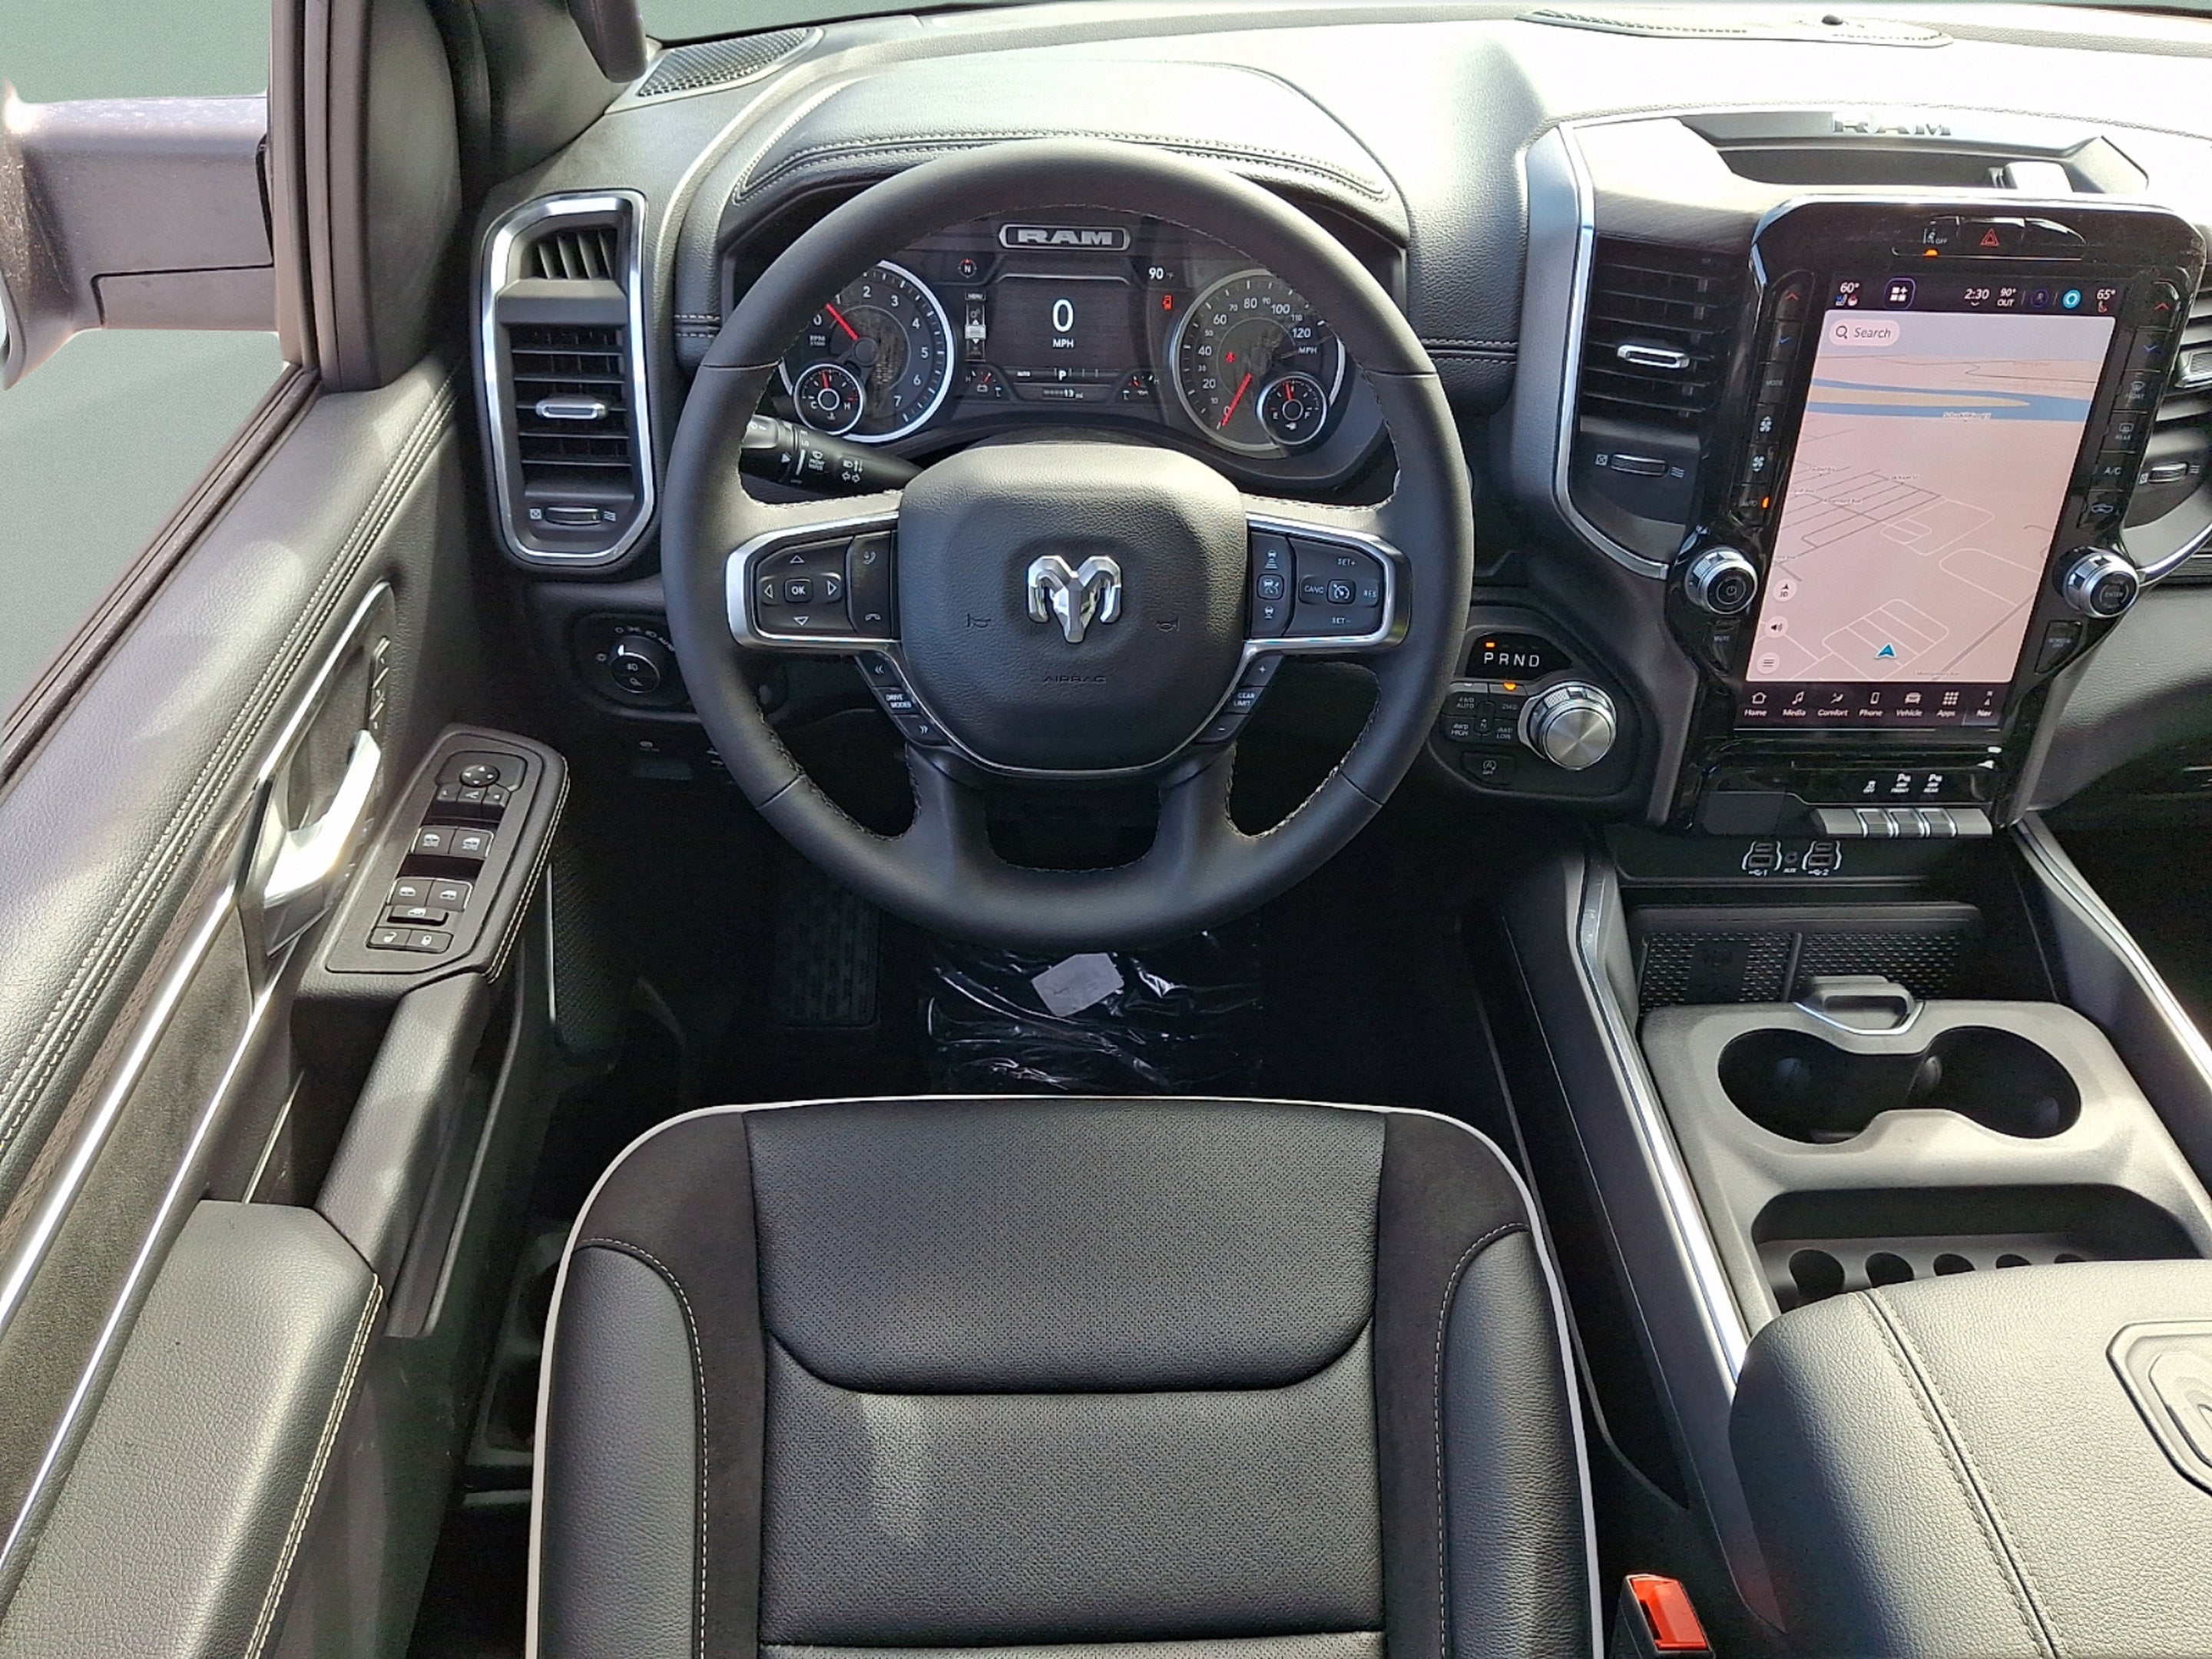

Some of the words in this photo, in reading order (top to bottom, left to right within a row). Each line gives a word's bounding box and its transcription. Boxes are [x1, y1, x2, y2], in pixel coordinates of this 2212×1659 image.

[1833, 119, 1952, 136] RAM
[1018, 229, 1113, 245] RAM
[1148, 267, 1164, 280] 90
[863, 286, 872, 298] 2
[1839, 282, 1859, 293] 60°
[1999, 287, 2017, 297] 90°
[835, 294, 842, 304] 1
[1964, 288, 1990, 300] 2:30
[2096, 289, 2116, 300] 65°
[891, 295, 899, 306] 3
[1243, 297, 1257, 309] 80
[1271, 303, 1291, 314] 100
[813, 314, 823, 326] 0
[1052, 299, 1074, 333] 0
[1213, 314, 1227, 325] 60
[912, 318, 920, 329] 4
[1292, 327, 1312, 338] 120
[1853, 327, 1892, 339] Search
[1052, 338, 1075, 349] MPH
[921, 348, 929, 358] 5
[1197, 346, 1212, 356] 40
[1297, 346, 1317, 355] MPH
[913, 375, 921, 385] 6
[1058, 369, 1067, 381] P
[1202, 379, 1216, 389] 20
[810, 400, 818, 409] C
[843, 402, 851, 410] H
[893, 396, 902, 406] 7
[1273, 412, 1278, 420] E
[1305, 411, 1311, 419] F
[2104, 466, 2122, 475] A/C
[791, 585, 806, 596] OK
[1304, 585, 1324, 594] CANC
[1936, 709, 1956, 718] Apps
